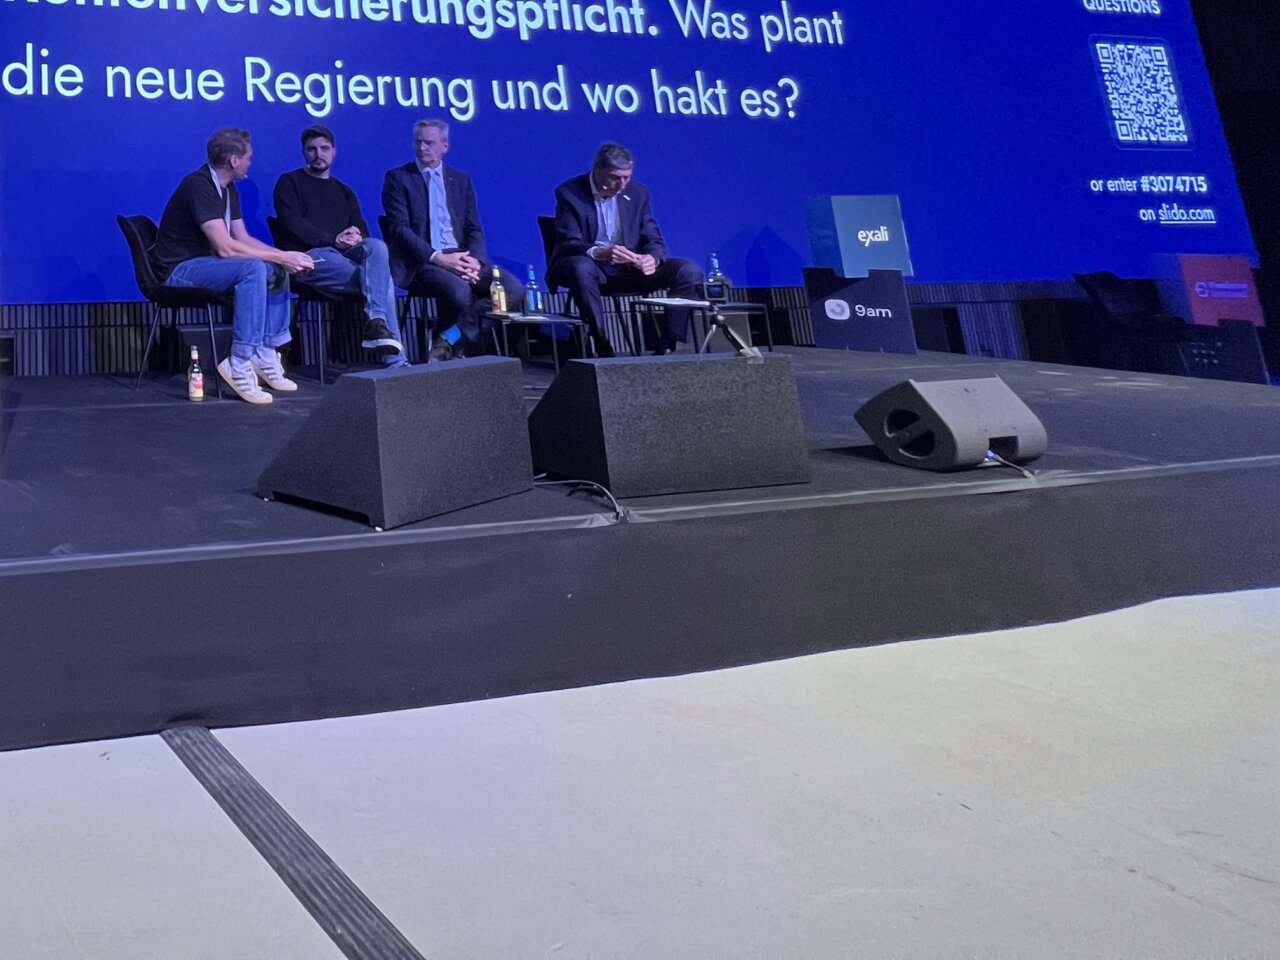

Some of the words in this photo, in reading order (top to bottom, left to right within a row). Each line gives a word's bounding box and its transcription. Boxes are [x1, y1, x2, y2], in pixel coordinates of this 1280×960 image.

[759, 0, 844, 53] plant
[1, 42, 85, 98] die
[105, 65, 226, 102] neue
[244, 56, 476, 122] Regierung
[491, 64, 570, 112] und
[580, 82, 640, 114] wo
[650, 68, 728, 116] hakt
[740, 77, 800, 119] es?
[1089, 179, 1104, 192] or
[1106, 177, 1138, 192] enter
[1139, 175, 1208, 193] #3074715
[1139, 208, 1157, 221] on
[1157, 202, 1215, 221] slido.com
[858, 226, 889, 247] exali
[855, 303, 892, 320] 9am
